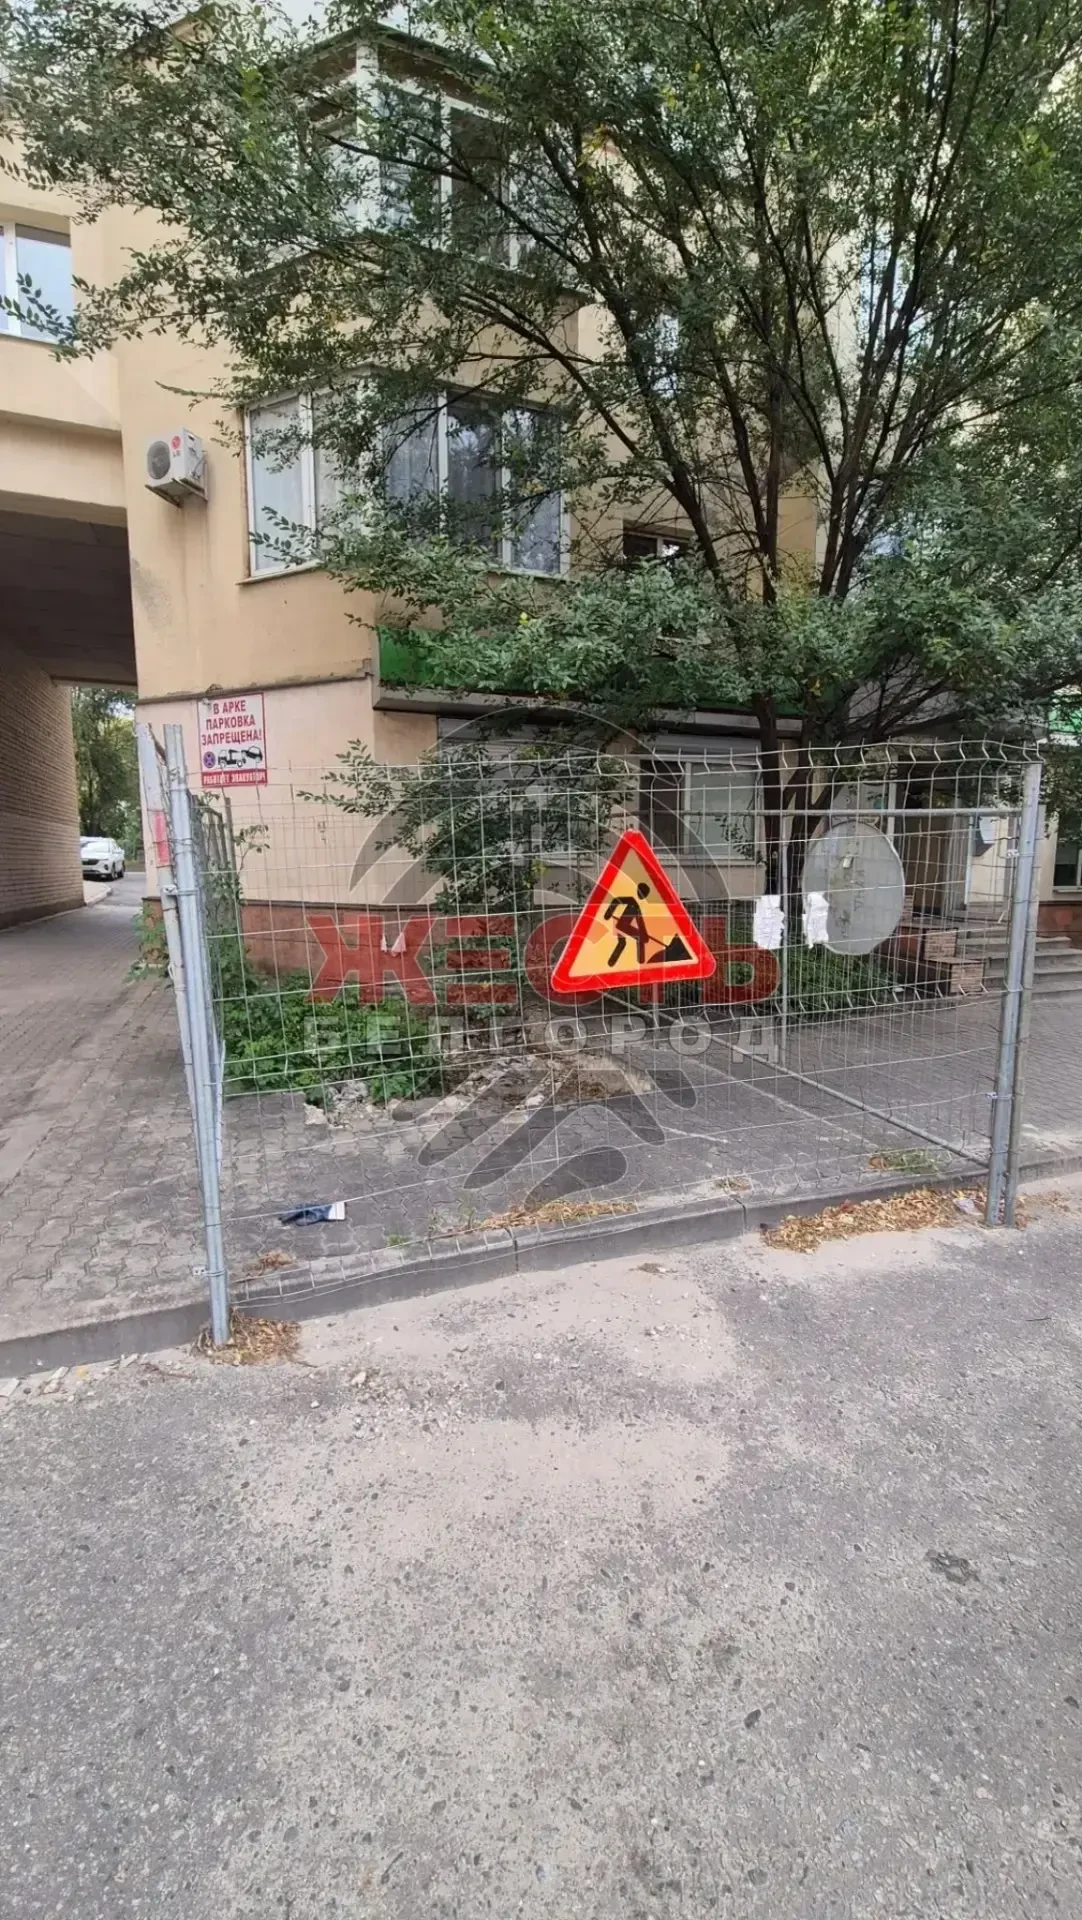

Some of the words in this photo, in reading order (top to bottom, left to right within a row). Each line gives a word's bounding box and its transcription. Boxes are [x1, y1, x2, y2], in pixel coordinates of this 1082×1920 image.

[213, 703, 220, 714] В
[222, 700, 246, 713] АРКЕ
[206, 714, 256, 730] ПАРКОВКА
[201, 729, 262, 746] ЗАПРЕЩЕНА!
